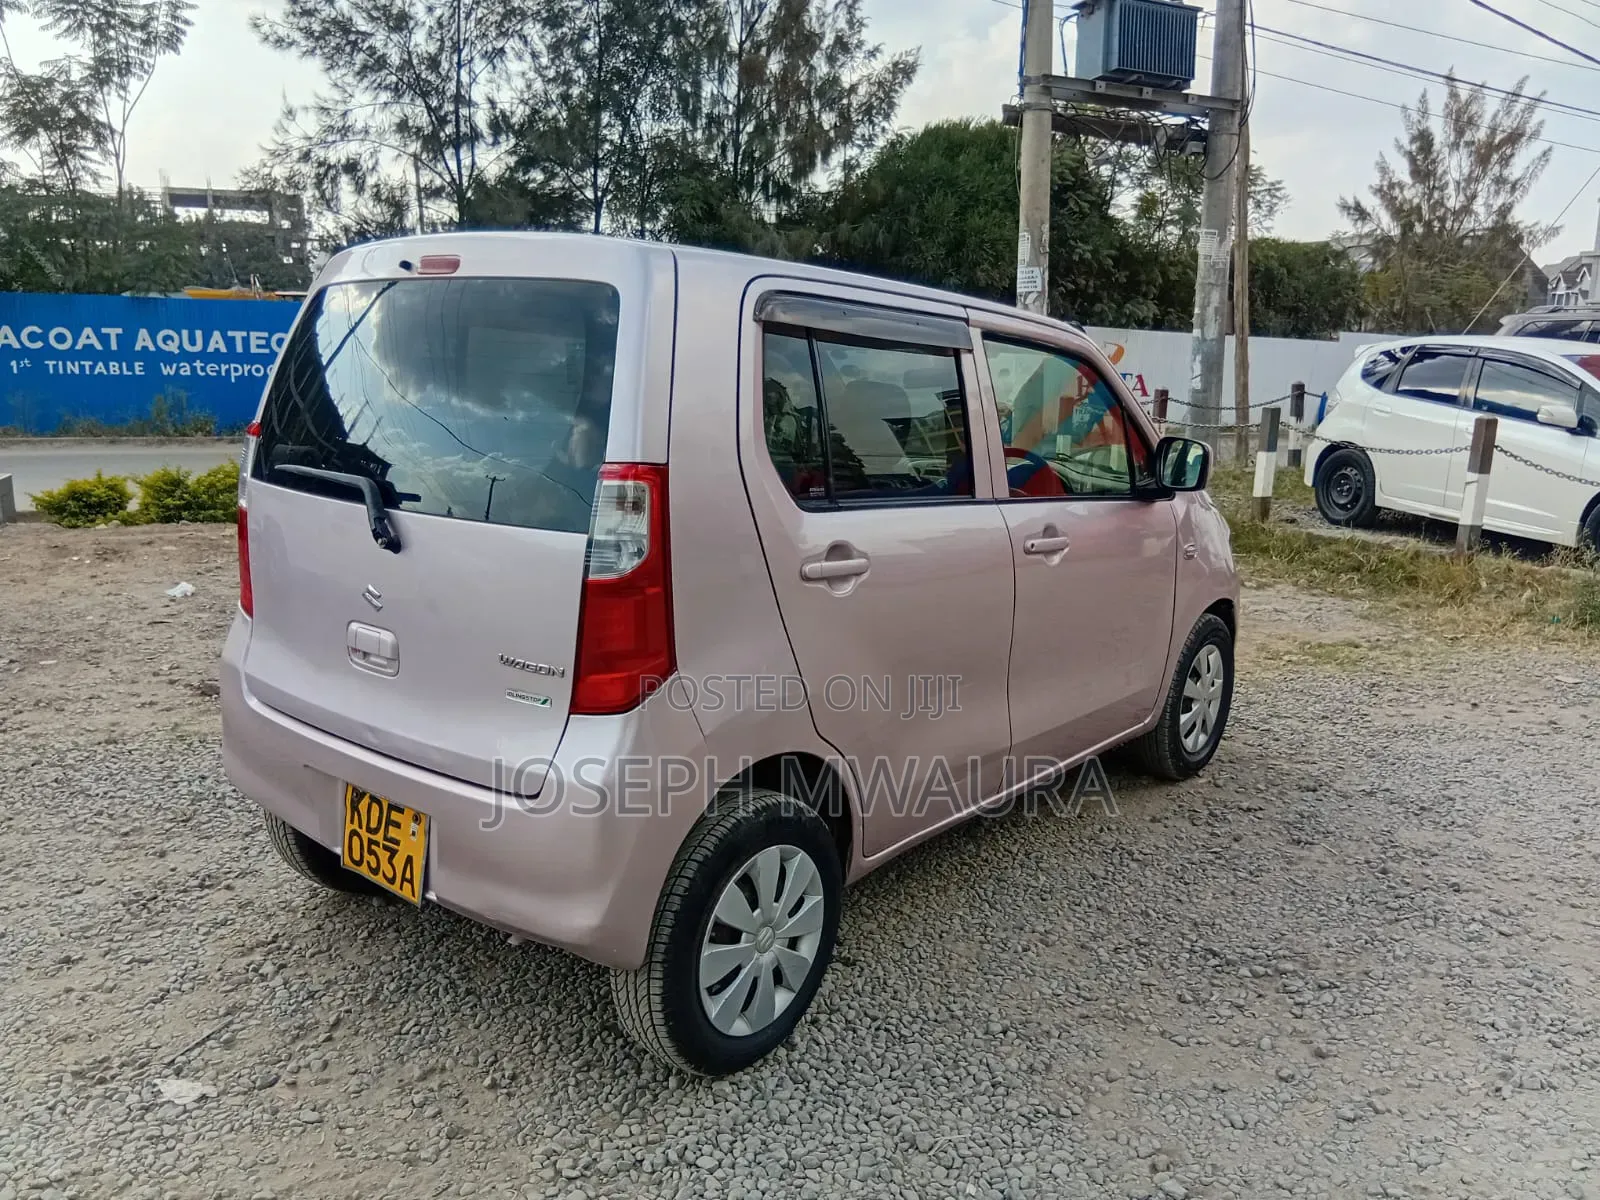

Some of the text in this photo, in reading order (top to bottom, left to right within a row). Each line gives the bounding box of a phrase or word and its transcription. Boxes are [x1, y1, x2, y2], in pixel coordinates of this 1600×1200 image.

[0, 325, 289, 353] ACOAT AQUATEC
[10, 357, 32, 375] 1st
[44, 360, 145, 376] TINTABLE
[498, 652, 565, 679] WAGON
[349, 785, 405, 848] KDE
[348, 828, 416, 899] 053A
